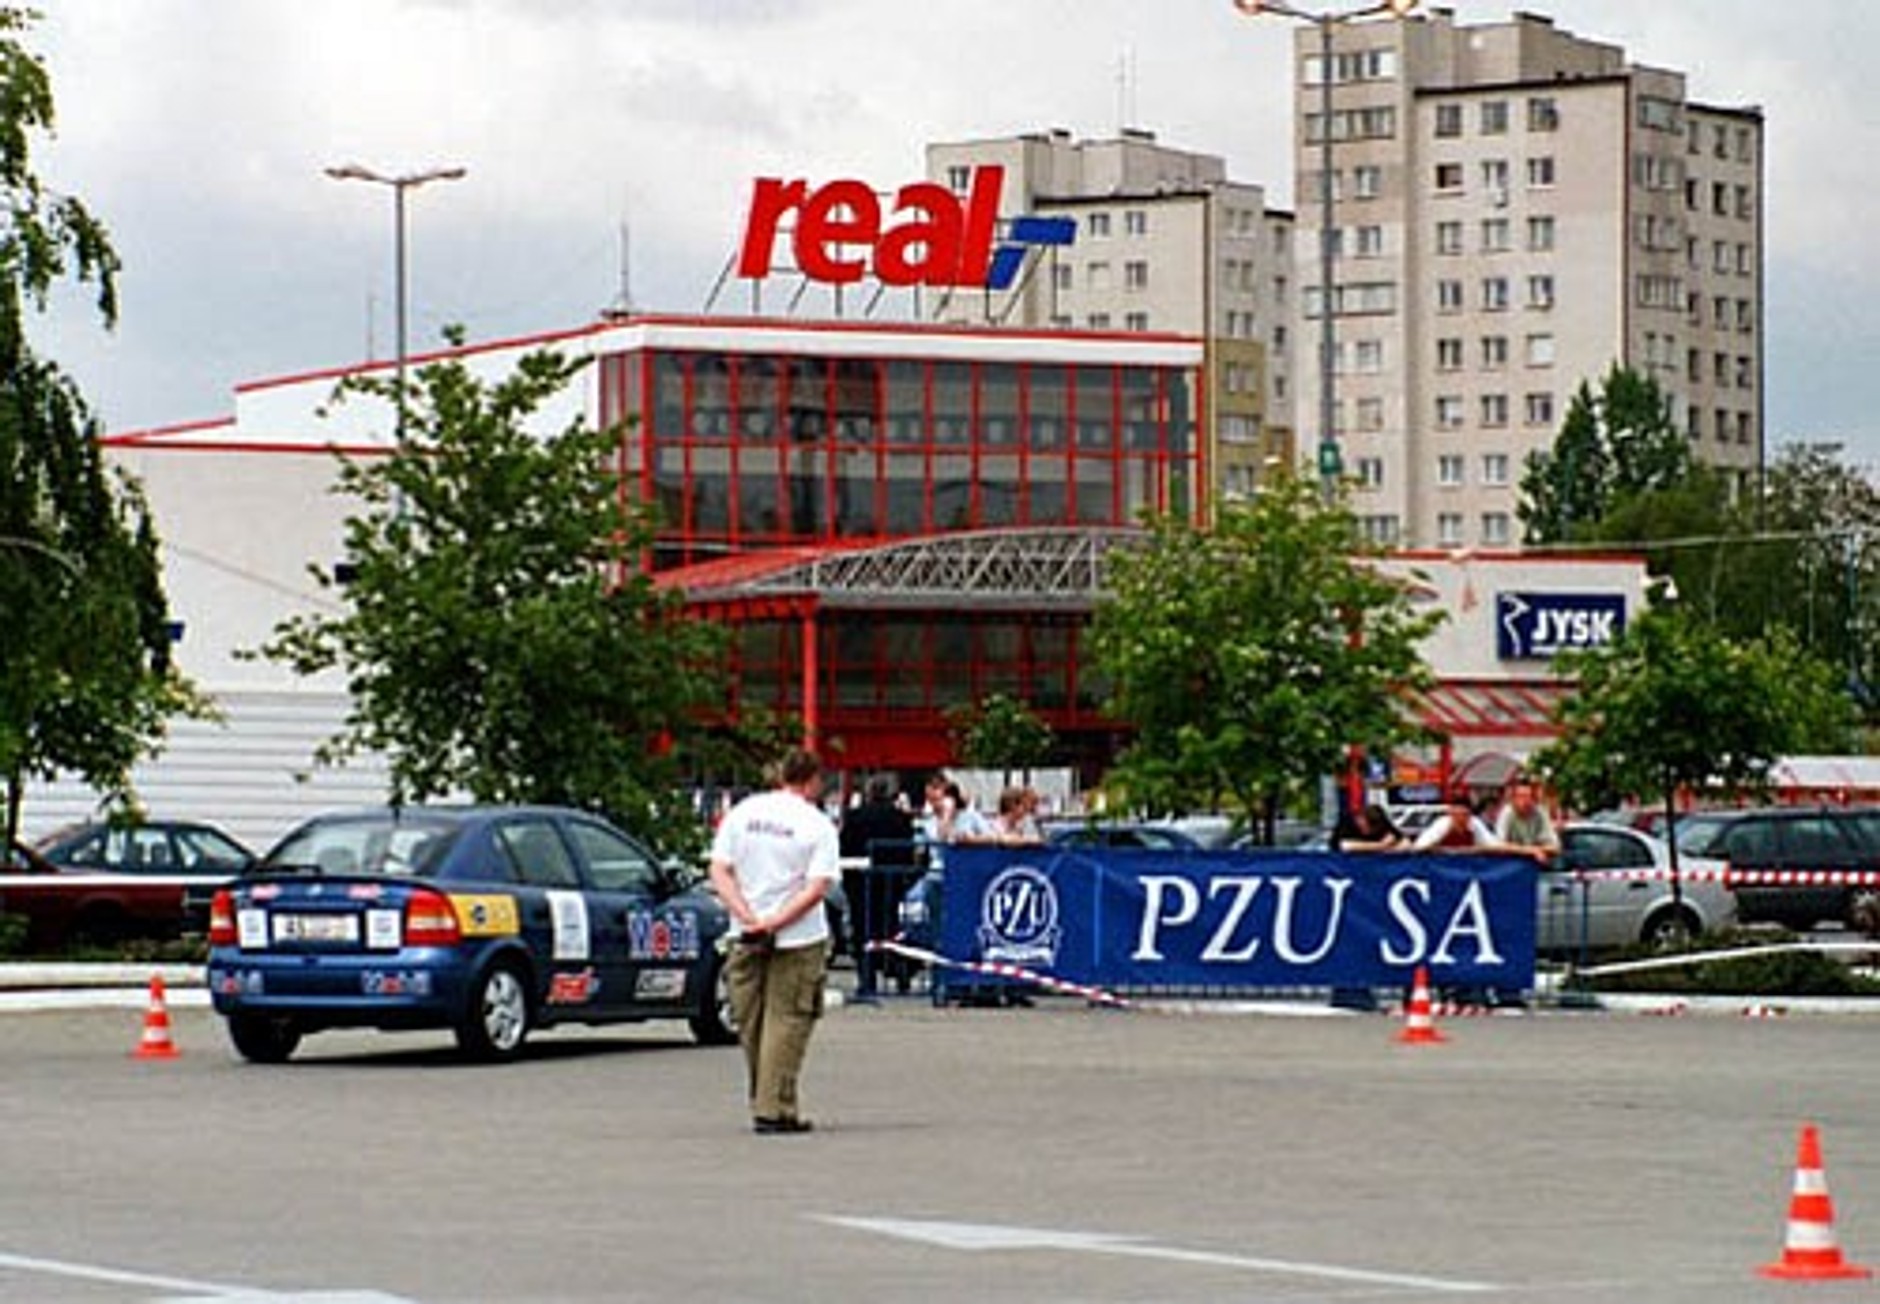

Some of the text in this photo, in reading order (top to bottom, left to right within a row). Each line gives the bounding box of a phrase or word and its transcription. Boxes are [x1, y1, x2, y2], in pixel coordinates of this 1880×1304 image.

[738, 165, 1004, 286] real
[1531, 609, 1615, 641] JYSK
[1132, 876, 1505, 965] PZU SA
